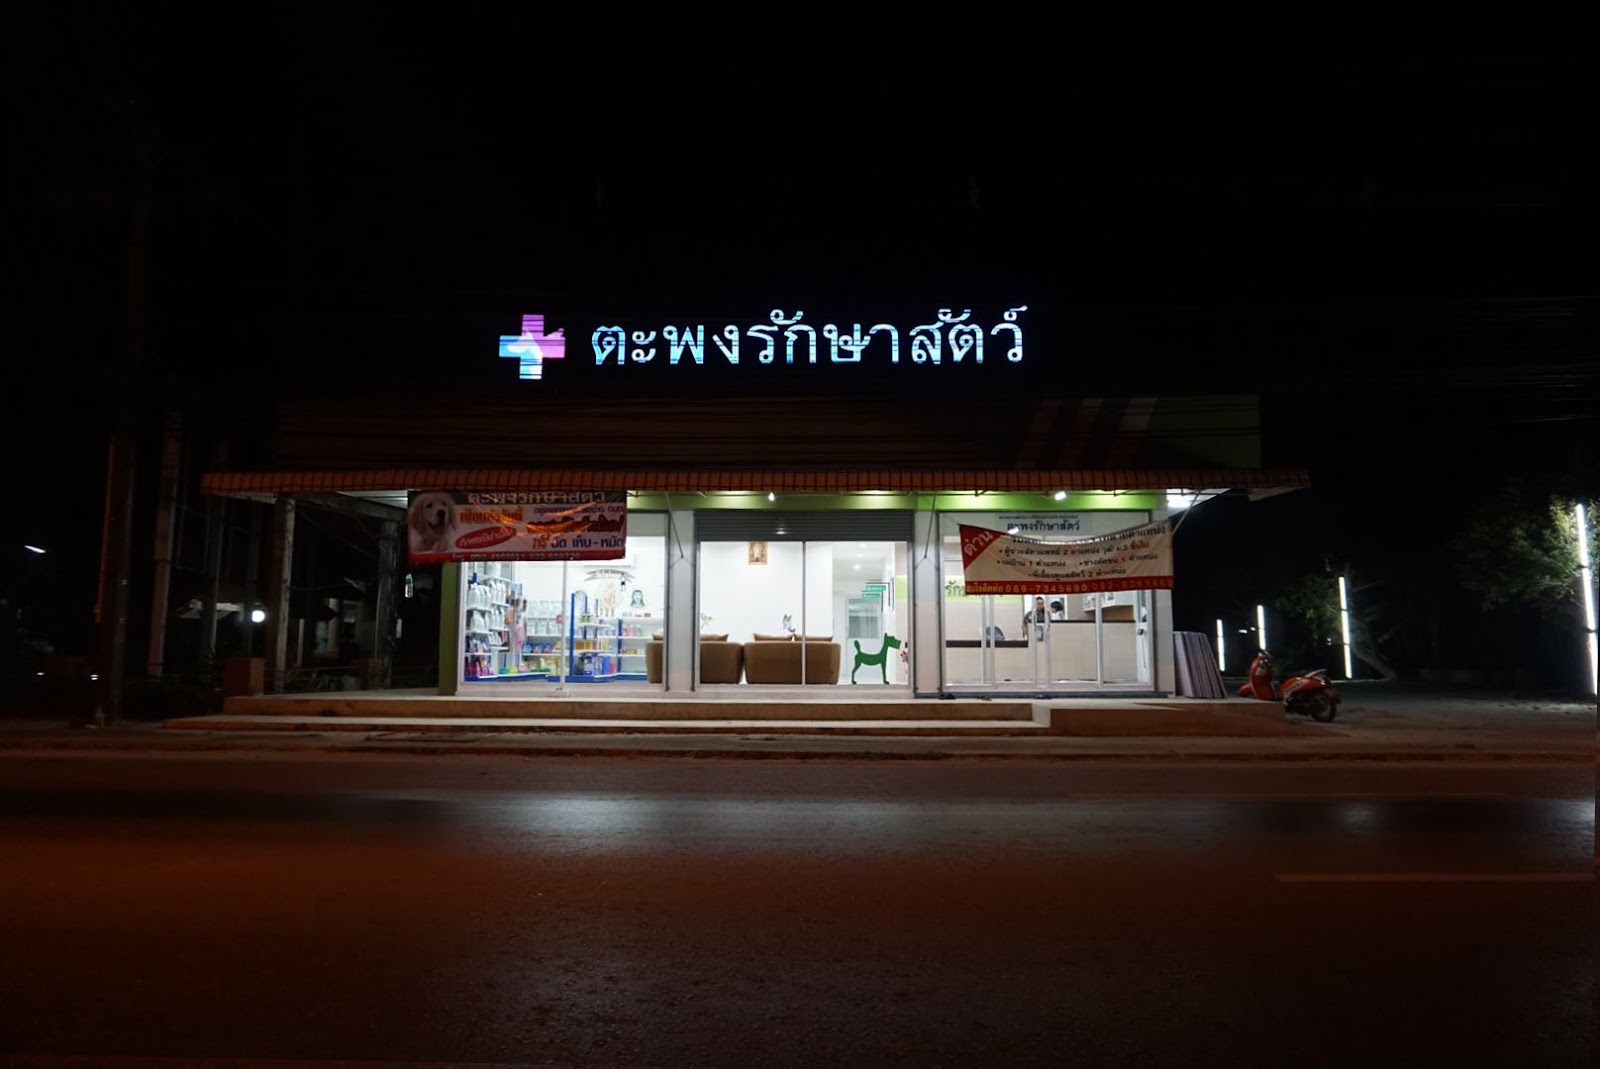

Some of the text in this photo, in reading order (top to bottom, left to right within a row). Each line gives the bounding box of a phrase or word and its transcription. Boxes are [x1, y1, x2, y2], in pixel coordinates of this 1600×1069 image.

[590, 304, 1028, 365] ตะพงรักษาสัตว์
[1007, 519, 1081, 531] ตะพงรักษาสัตว์
[962, 529, 994, 557] ด่วน
